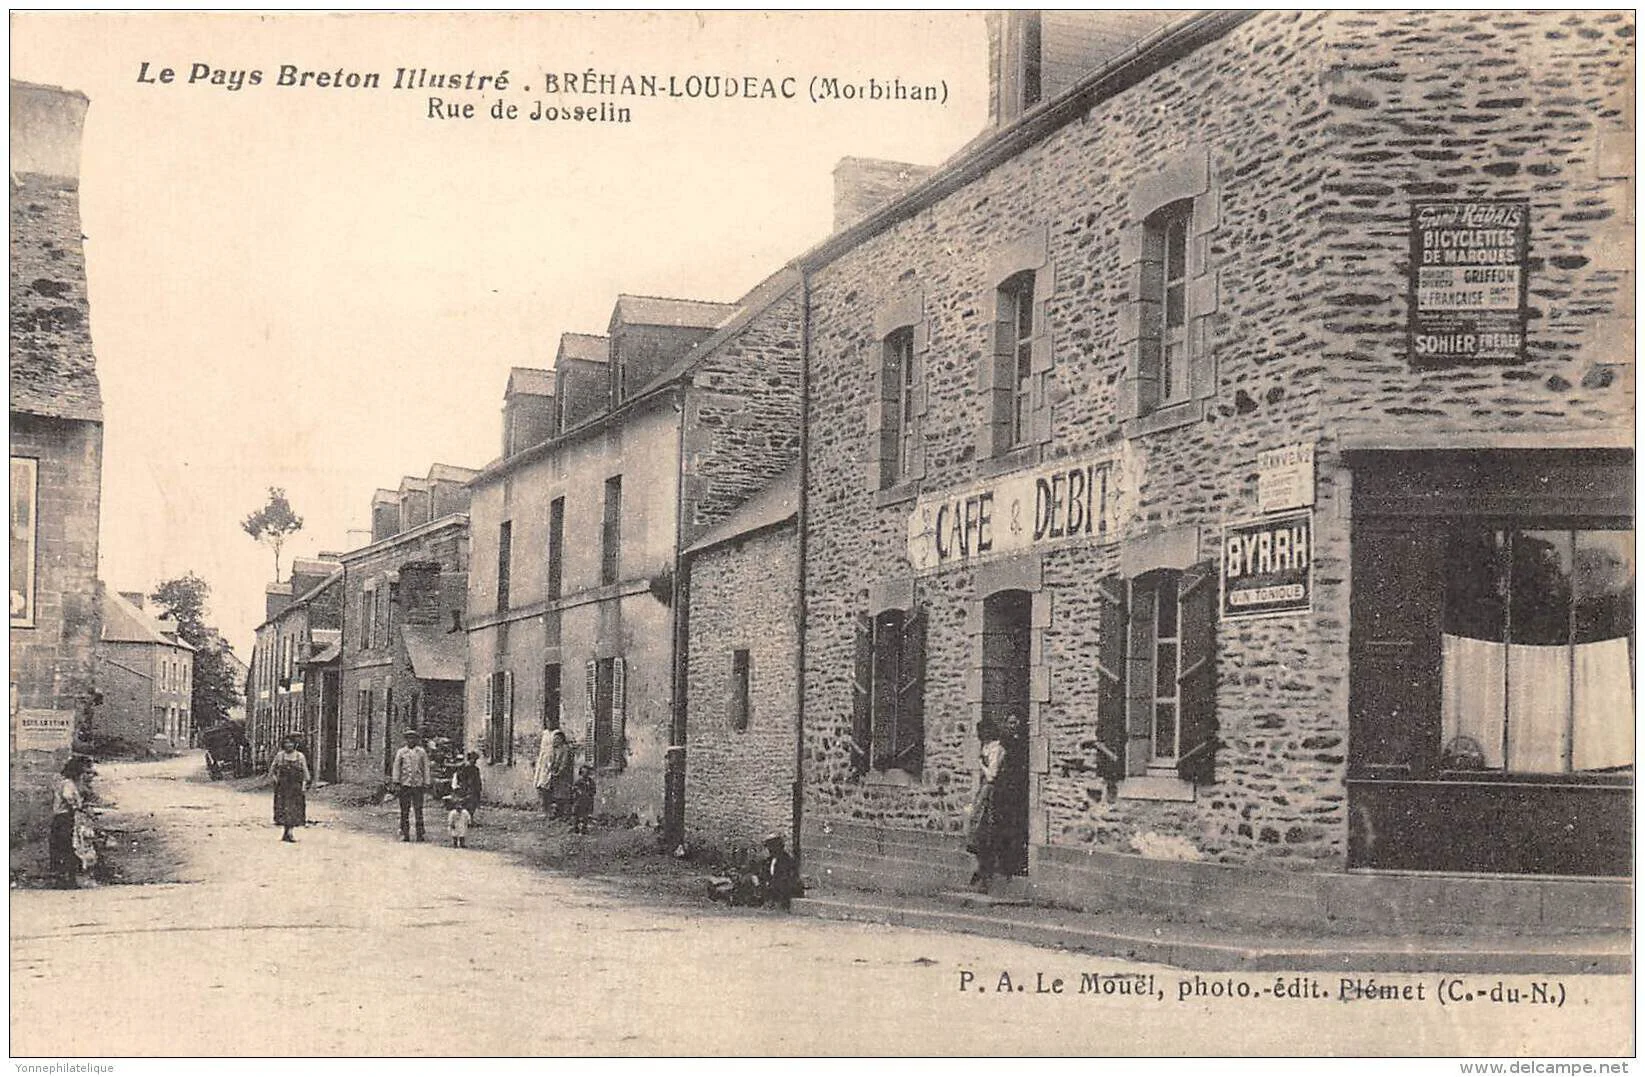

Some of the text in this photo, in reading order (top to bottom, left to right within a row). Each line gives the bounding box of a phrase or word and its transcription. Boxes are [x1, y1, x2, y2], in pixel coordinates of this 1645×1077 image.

[1423, 229, 1516, 248] BICYCLETTES
[1423, 248, 1516, 266] DE MARQUES
[1463, 269, 1515, 284] GRIFFON
[1415, 335, 1476, 354] SOHIER
[936, 491, 994, 560] CAFE
[1033, 460, 1114, 541] DEBIT
[1227, 525, 1308, 578] BYRRH
[1254, 585, 1302, 602] TONIQUE
